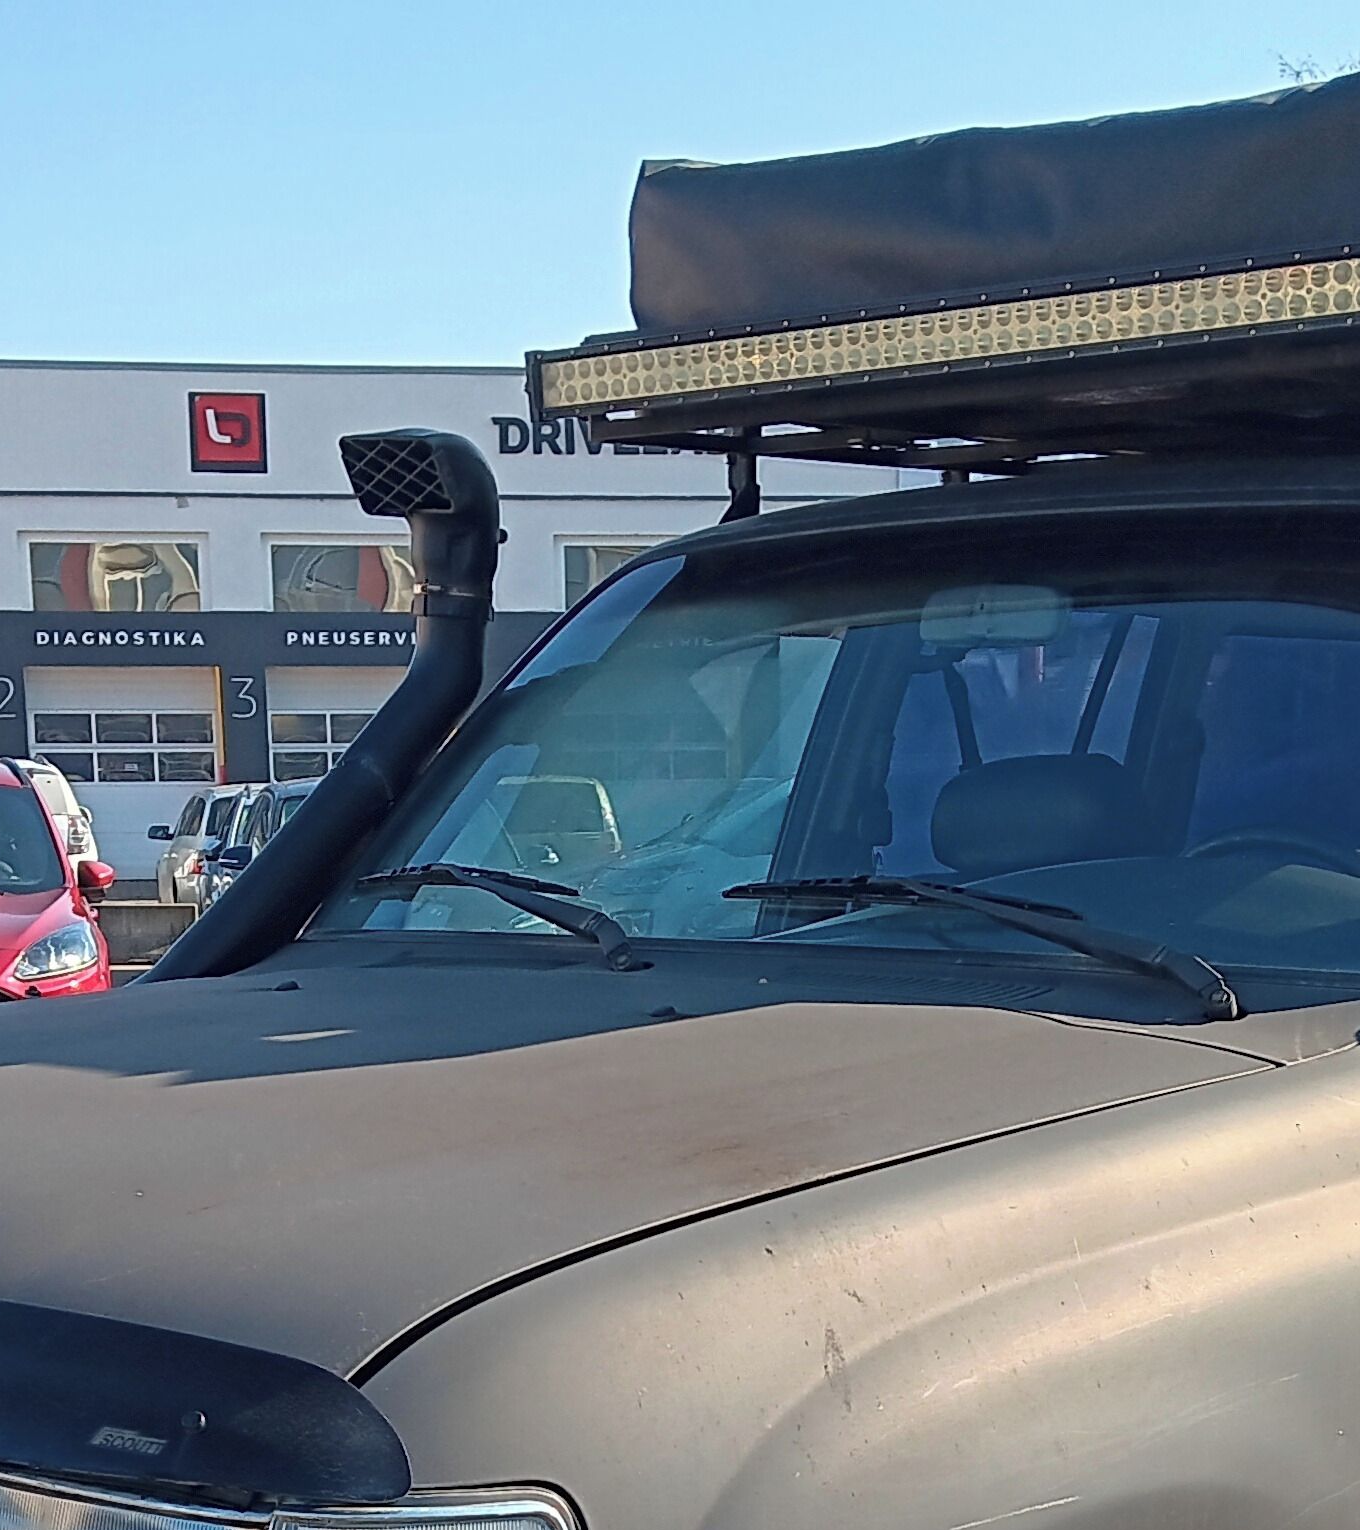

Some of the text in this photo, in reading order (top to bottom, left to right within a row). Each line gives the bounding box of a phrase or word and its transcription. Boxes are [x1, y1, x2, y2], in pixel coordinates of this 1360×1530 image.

[34, 630, 206, 647] DIAGNOSTIKA
[286, 630, 417, 647] PNEUSERVI
[230, 676, 257, 719] 3
